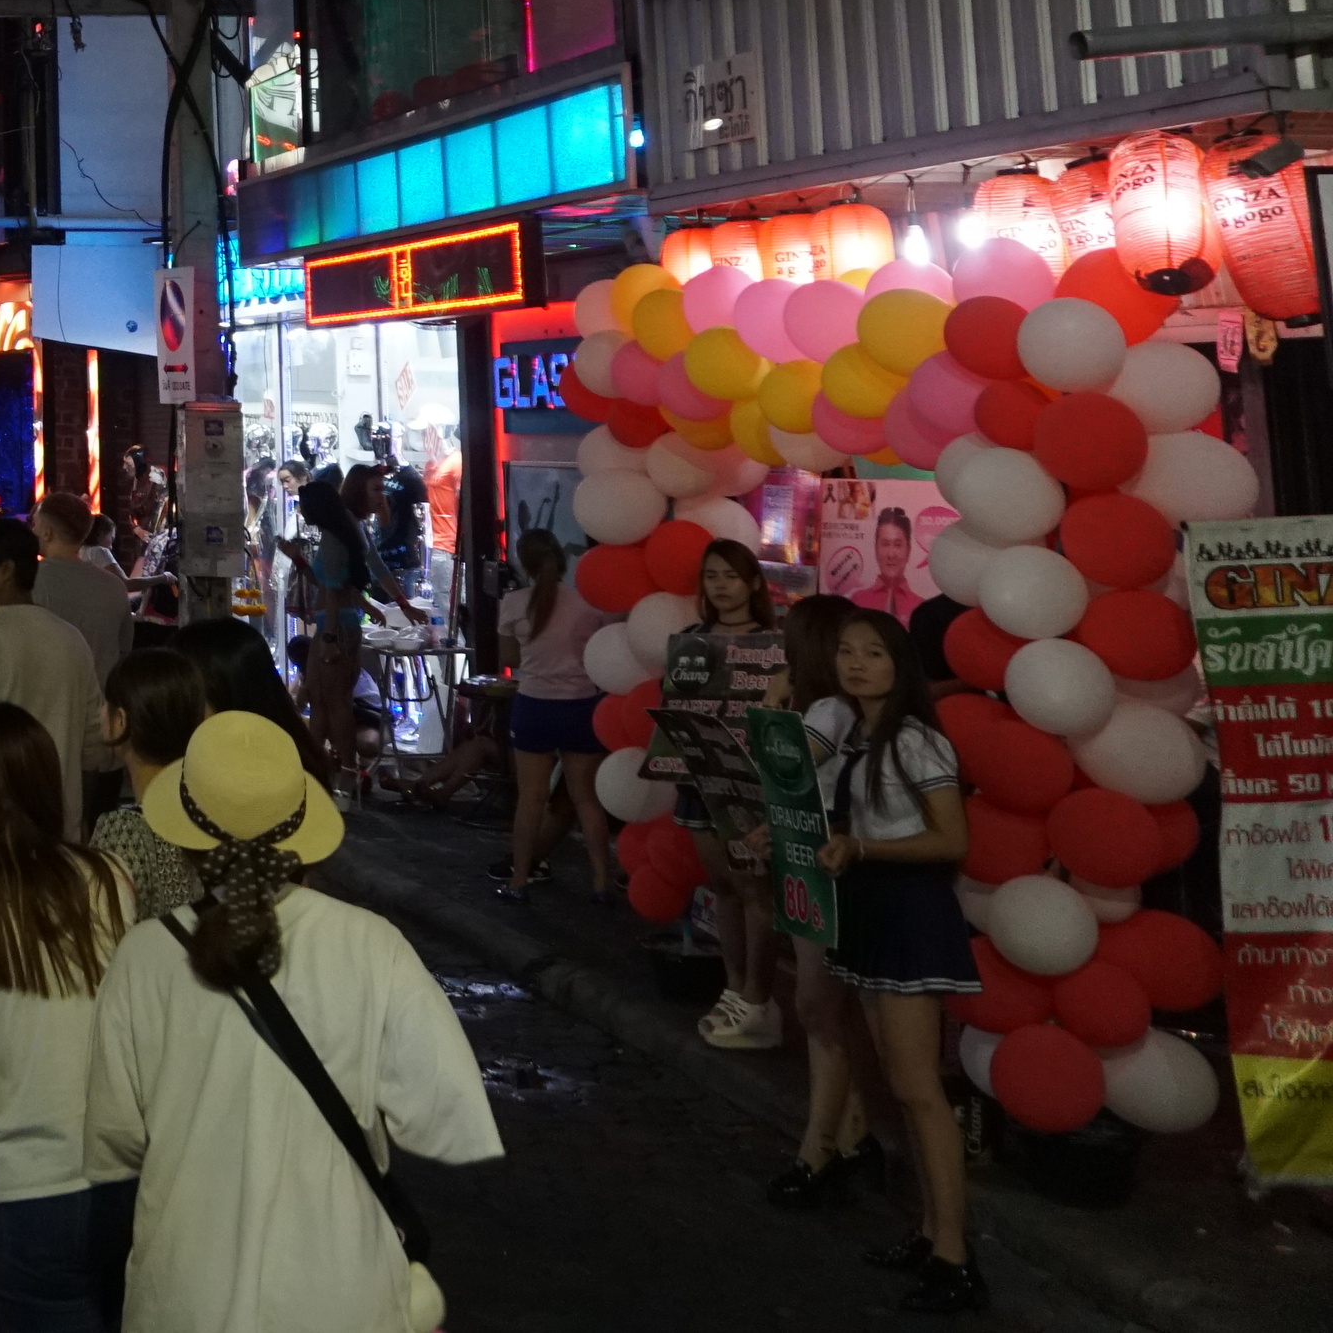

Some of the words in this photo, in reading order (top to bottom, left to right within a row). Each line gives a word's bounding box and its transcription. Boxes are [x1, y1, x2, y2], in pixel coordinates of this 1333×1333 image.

[1213, 187, 1281, 212] GINZA
[726, 645, 787, 666] Draugh
[671, 665, 710, 686] Chang
[1288, 772, 1321, 793] 50
[770, 804, 822, 835] DRAUGHT
[786, 843, 816, 868] BEER
[783, 874, 809, 921] 80
